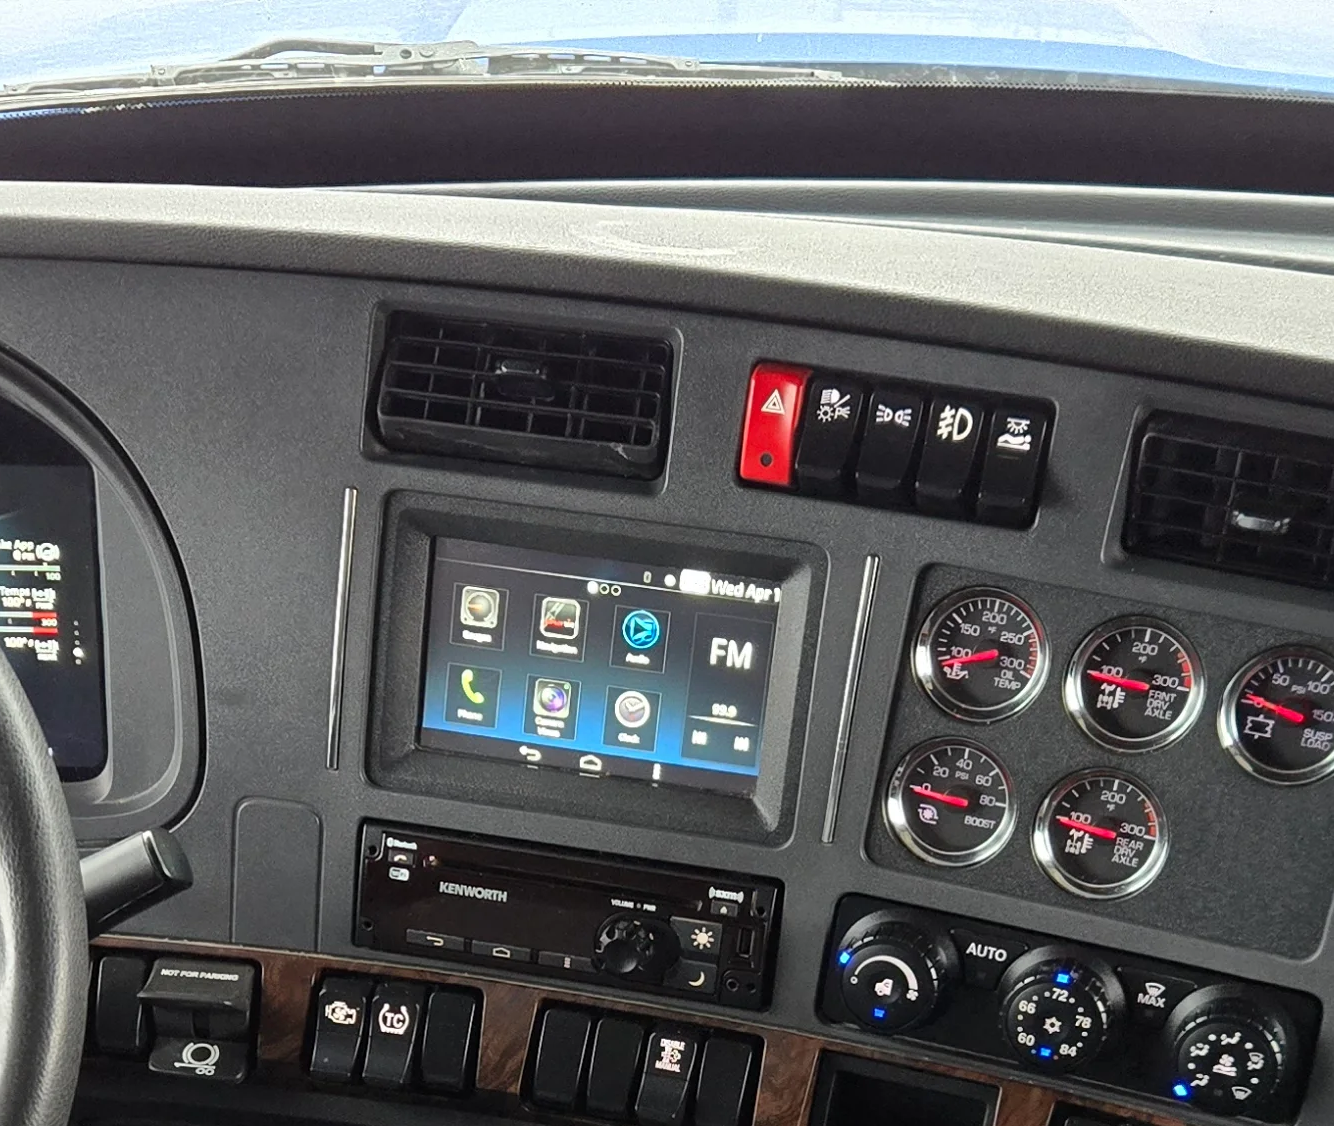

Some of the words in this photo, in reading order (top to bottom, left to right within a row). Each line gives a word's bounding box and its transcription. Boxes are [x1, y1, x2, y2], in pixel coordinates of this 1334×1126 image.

[13, 539, 34, 551] App
[45, 572, 61, 580] 100
[712, 578, 744, 598] Wed
[745, 583, 772, 604] Apr
[982, 611, 1007, 625] 200
[959, 623, 981, 636] 150
[1000, 631, 1025, 645] 250
[709, 637, 753, 670] FM
[951, 646, 971, 658] 100
[1132, 642, 1158, 656] 200
[1000, 656, 1024, 671] 300
[1000, 670, 1014, 680] OIL
[1100, 665, 1123, 678] 100
[994, 677, 1021, 690] TEMP
[1152, 674, 1179, 688] 300
[1272, 674, 1290, 686] 50
[1291, 684, 1306, 694] PSI
[1307, 681, 1330, 694] 100
[1148, 689, 1177, 703] FRNT
[1146, 699, 1170, 709] DRV
[1144, 709, 1173, 720] AXLE
[1312, 709, 1334, 722] 150
[1302, 728, 1333, 741] SUSP
[1300, 737, 1331, 751] LOAD
[956, 758, 973, 770] 40
[932, 767, 949, 778] 20
[955, 771, 969, 780] PSI
[975, 775, 992, 787] 60
[979, 794, 996, 806] 80
[1100, 790, 1126, 804] 200
[964, 815, 996, 829] BOOST
[1069, 811, 1091, 825] 100
[1119, 823, 1145, 837] 300
[1116, 837, 1143, 851] REAR
[1113, 846, 1136, 857] DRV
[1111, 855, 1139, 868] AXLE
[439, 881, 508, 902] KENWORTH
[611, 899, 634, 909] VOLUME
[643, 903, 657, 912] PWR
[966, 942, 1008, 962] AUTO
[160, 968, 179, 977] NOT
[180, 970, 199, 978] FOR
[199, 971, 239, 981] PARKING
[1051, 987, 1069, 1002] 72
[1137, 993, 1166, 1008] MAX
[1018, 1000, 1036, 1014] 66
[384, 1012, 404, 1028] TC
[1075, 1015, 1092, 1029] 78
[1017, 1032, 1035, 1046] 60
[1059, 1043, 1077, 1057] 84
